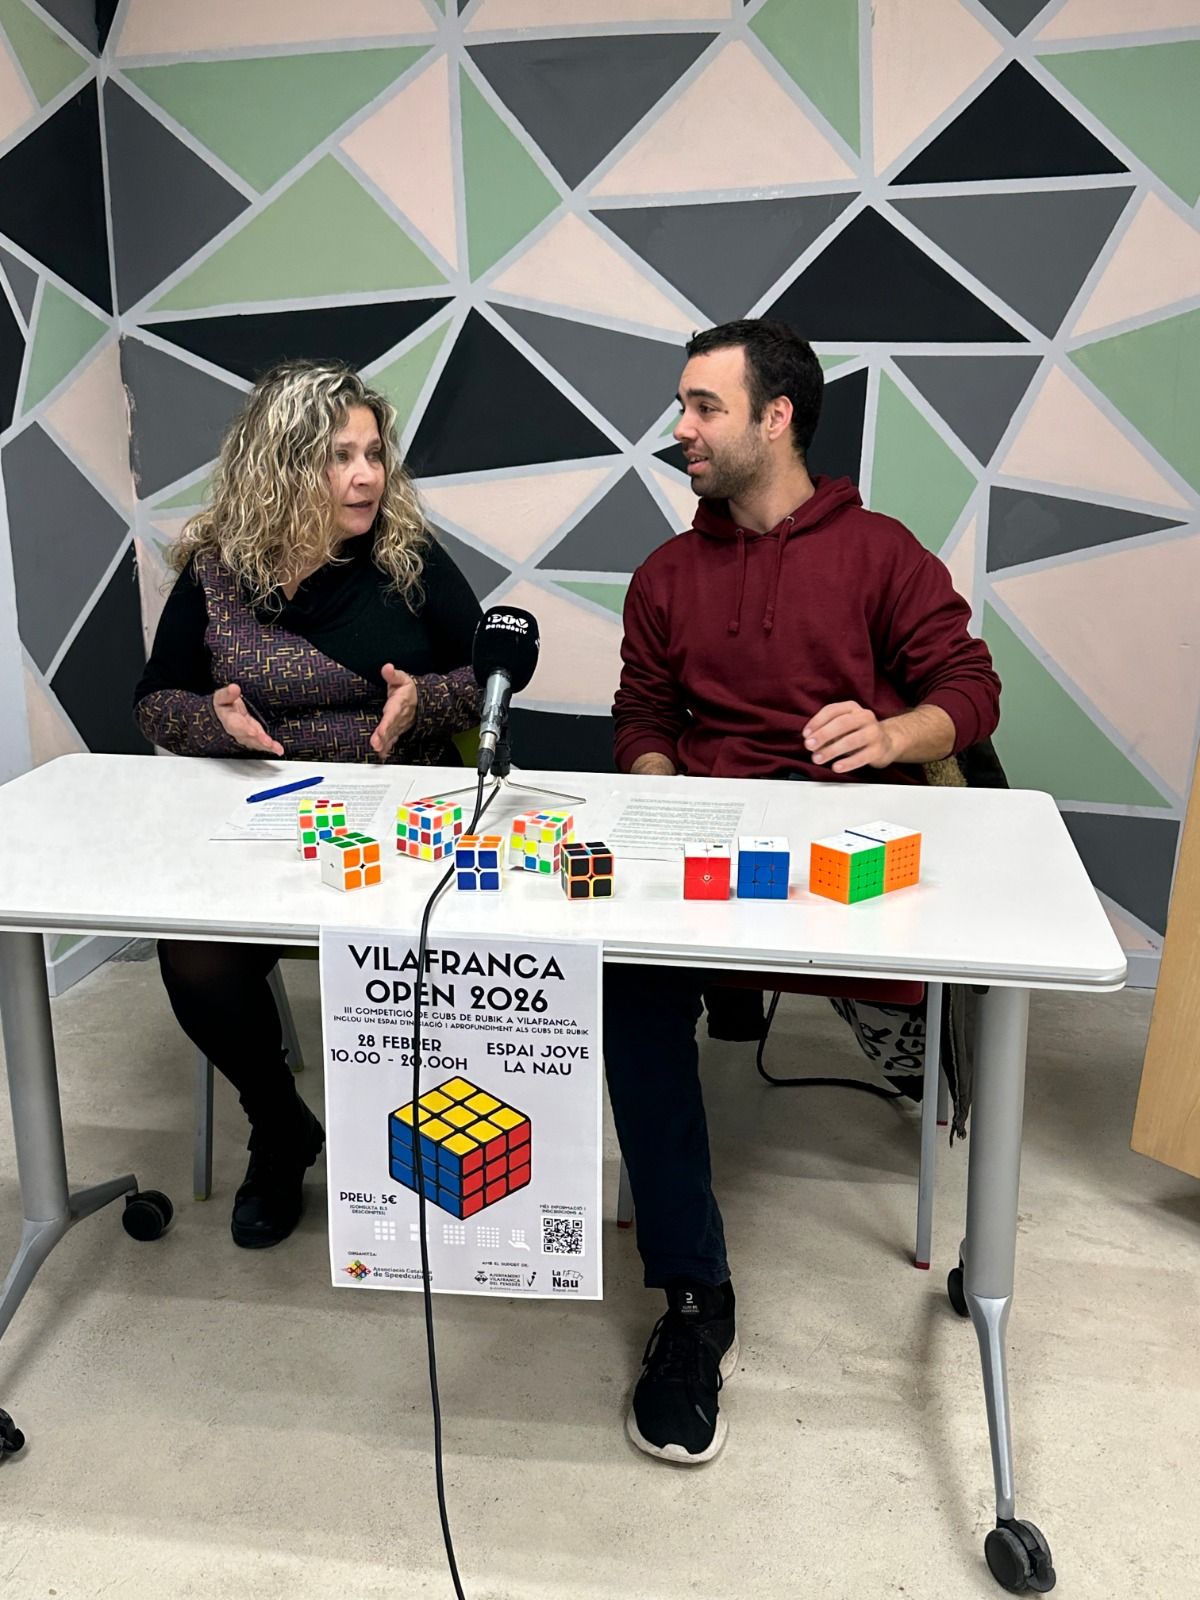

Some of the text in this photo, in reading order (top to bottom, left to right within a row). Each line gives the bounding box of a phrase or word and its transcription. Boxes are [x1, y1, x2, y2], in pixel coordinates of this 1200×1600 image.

[348, 944, 565, 980] VILAFRANCA
[365, 979, 548, 1013] OPEN 2026
[344, 1006, 352, 1014] III
[355, 1007, 413, 1018] COMPETICIÓ
[432, 1012, 456, 1021] CUBS
[460, 1013, 472, 1021] DE
[475, 1014, 503, 1024] RUBIK
[506, 1016, 514, 1024] A
[517, 1016, 577, 1027] VILAFRANCA
[333, 1015, 362, 1023] INCLOU
[450, 1022, 513, 1033] APROFUNDIMENT
[531, 1027, 551, 1035] CUBS
[358, 1034, 375, 1048] 28
[331, 1048, 381, 1064] 10.00
[487, 1042, 589, 1059] ESPAI JOVE
[504, 1060, 572, 1076] LA NAU
[340, 1191, 397, 1205] PREU: 5€
[552, 1277, 578, 1288] Nau
